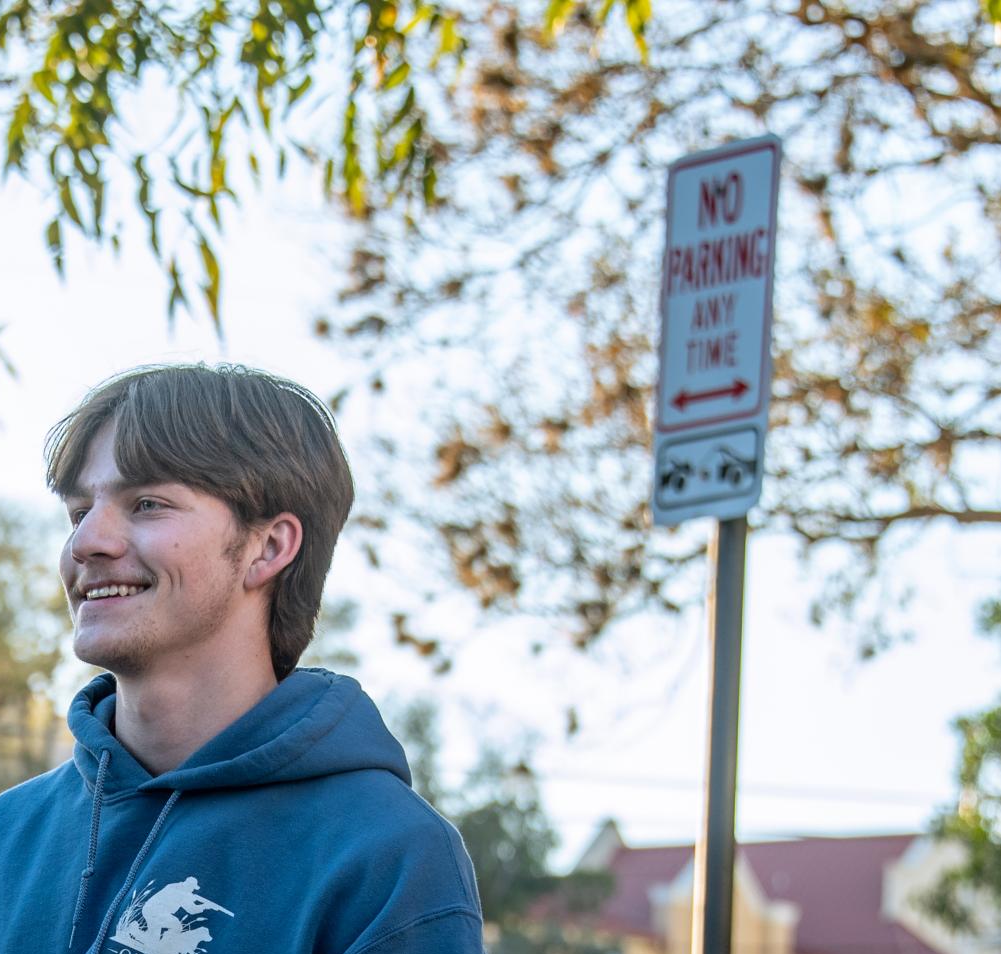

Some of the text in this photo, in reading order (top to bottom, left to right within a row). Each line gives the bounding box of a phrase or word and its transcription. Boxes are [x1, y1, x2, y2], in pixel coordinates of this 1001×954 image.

[698, 170, 743, 226] NO
[667, 229, 767, 294] PARKING
[692, 294, 736, 330] ANY
[687, 331, 738, 372] TIME
